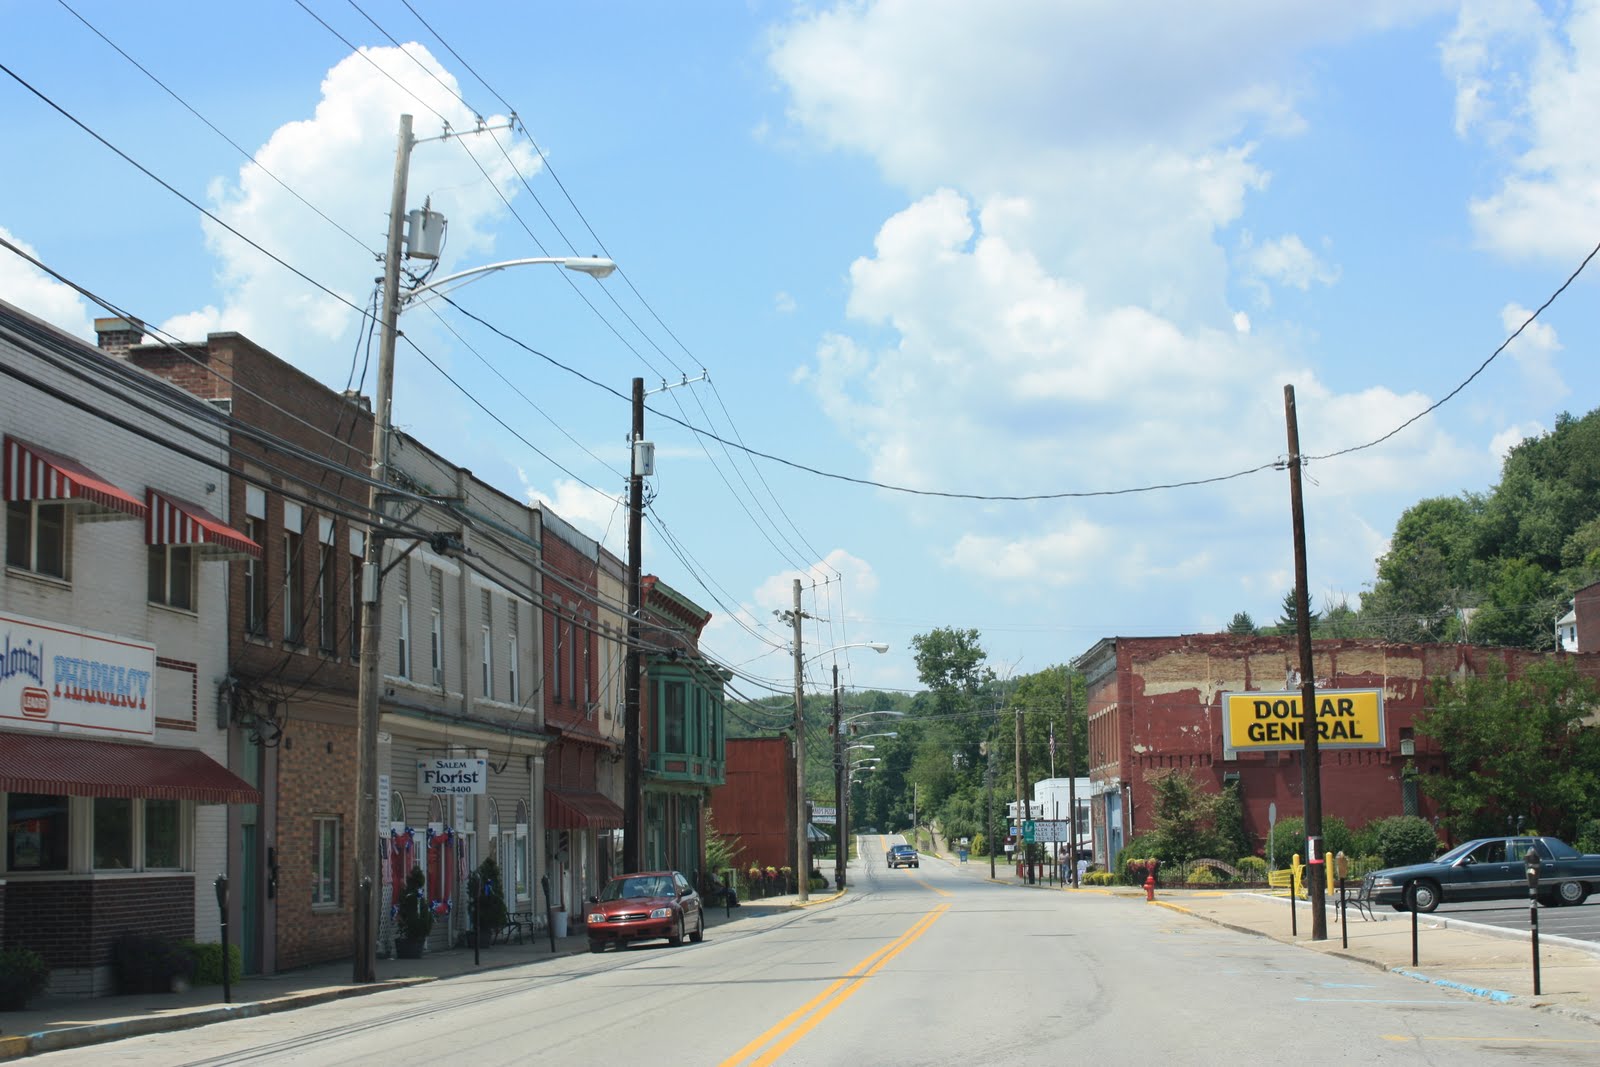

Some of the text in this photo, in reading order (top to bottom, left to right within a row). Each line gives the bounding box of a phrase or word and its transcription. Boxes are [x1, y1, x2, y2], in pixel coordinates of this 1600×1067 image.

[0, 632, 150, 710] olonial PHARMACY
[1253, 698, 1355, 719] DOLAR
[436, 760, 467, 768] SALEM
[424, 770, 479, 783] Florist
